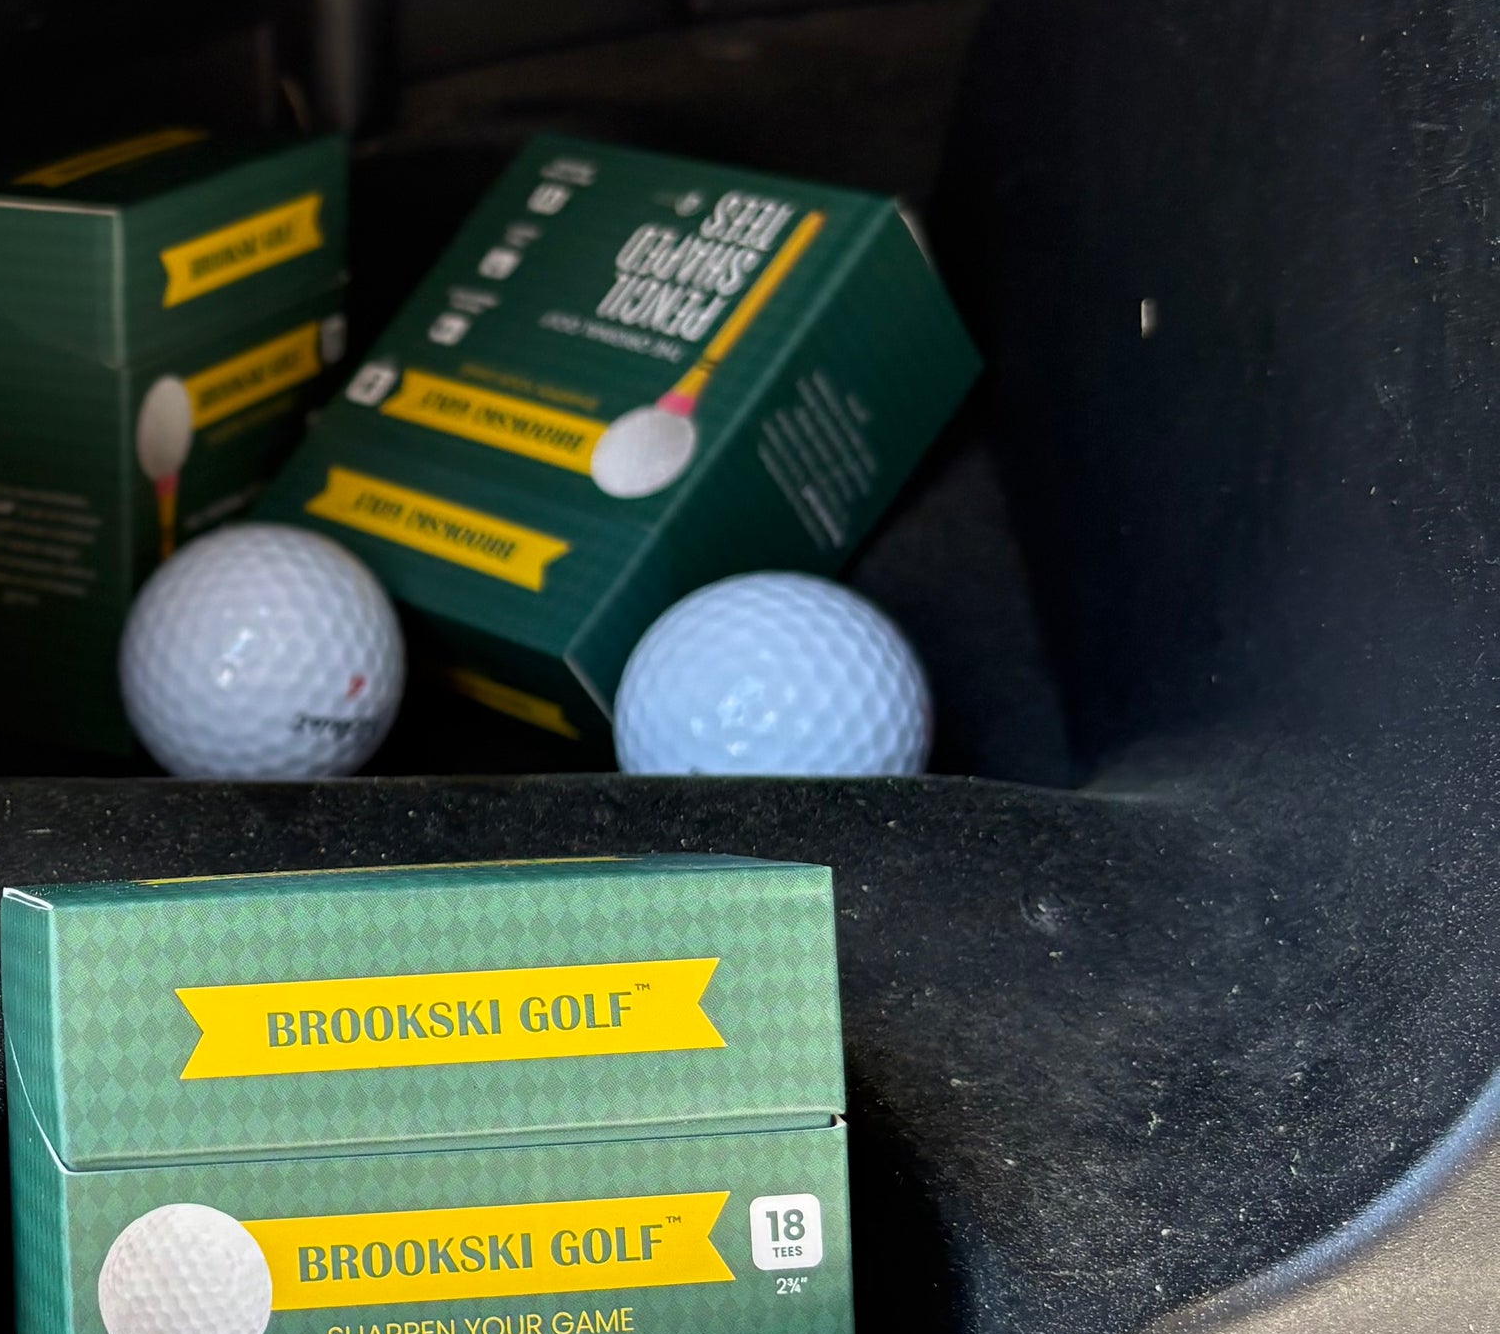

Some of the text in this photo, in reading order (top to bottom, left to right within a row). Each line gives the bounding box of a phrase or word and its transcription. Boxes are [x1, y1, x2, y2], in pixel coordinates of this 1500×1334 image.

[266, 998, 502, 1047] BROOKSKI
[765, 1208, 806, 1242] 18
[297, 1232, 533, 1283] BROOKSKI
[771, 1246, 803, 1259] TEES
